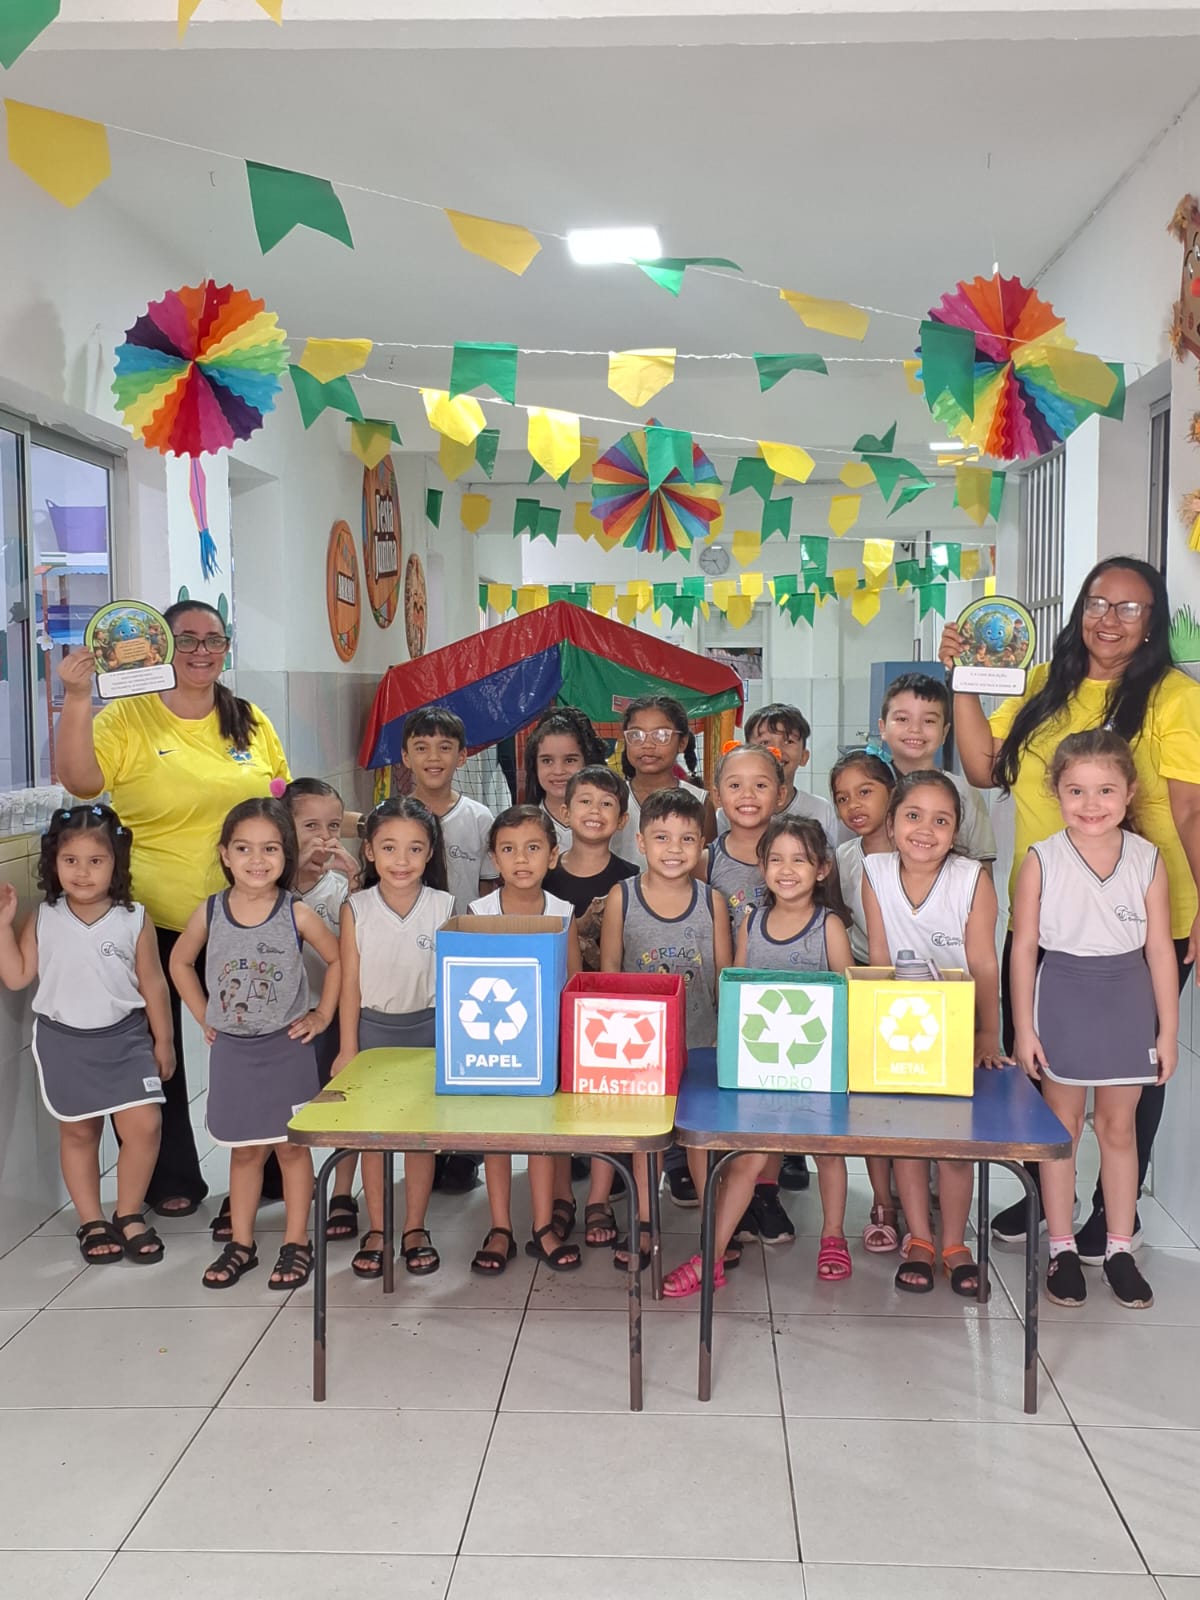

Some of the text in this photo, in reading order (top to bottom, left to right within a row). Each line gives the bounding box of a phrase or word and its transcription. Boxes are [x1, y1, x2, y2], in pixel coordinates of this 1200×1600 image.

[376, 495, 394, 532] Festa
[465, 1054, 523, 1068] PAPEL
[890, 1062, 929, 1075] METAL
[578, 1075, 659, 1095] PLÁSTICO
[758, 1074, 813, 1090] VIDRO
